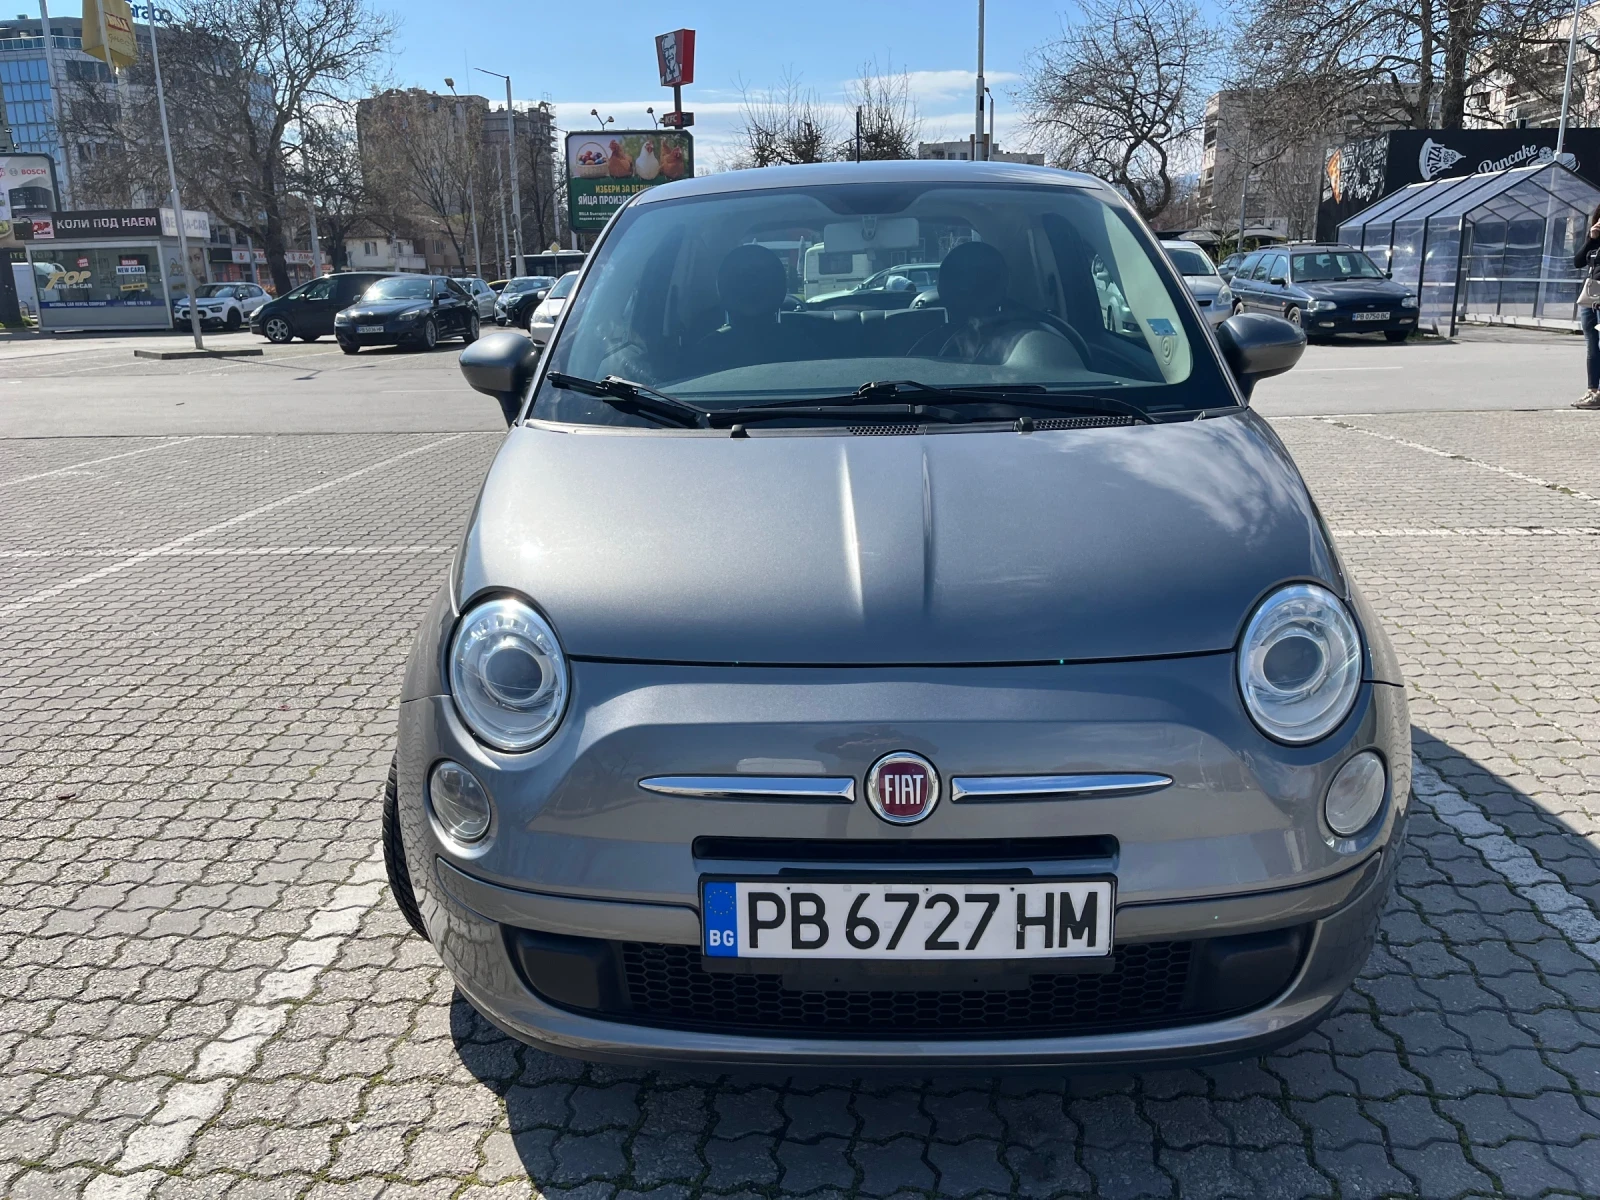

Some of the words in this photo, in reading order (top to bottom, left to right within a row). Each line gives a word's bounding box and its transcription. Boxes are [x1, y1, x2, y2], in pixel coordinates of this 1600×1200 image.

[665, 114, 677, 124] KFC
[1478, 144, 1538, 173] Pancake
[595, 185, 620, 193] ИЗБЕРИ
[622, 185, 630, 193] ЗА
[578, 193, 598, 206] ЯЙЦА
[56, 219, 90, 229] КОЛИ
[93, 218, 119, 229] ПОД
[122, 216, 157, 227] НАЕМ
[44, 271, 91, 291] TOP
[884, 773, 925, 806] FIAT
[747, 891, 830, 951] PB
[845, 892, 1001, 951] 6727
[1015, 891, 1099, 951] HM
[709, 929, 735, 947] BG
